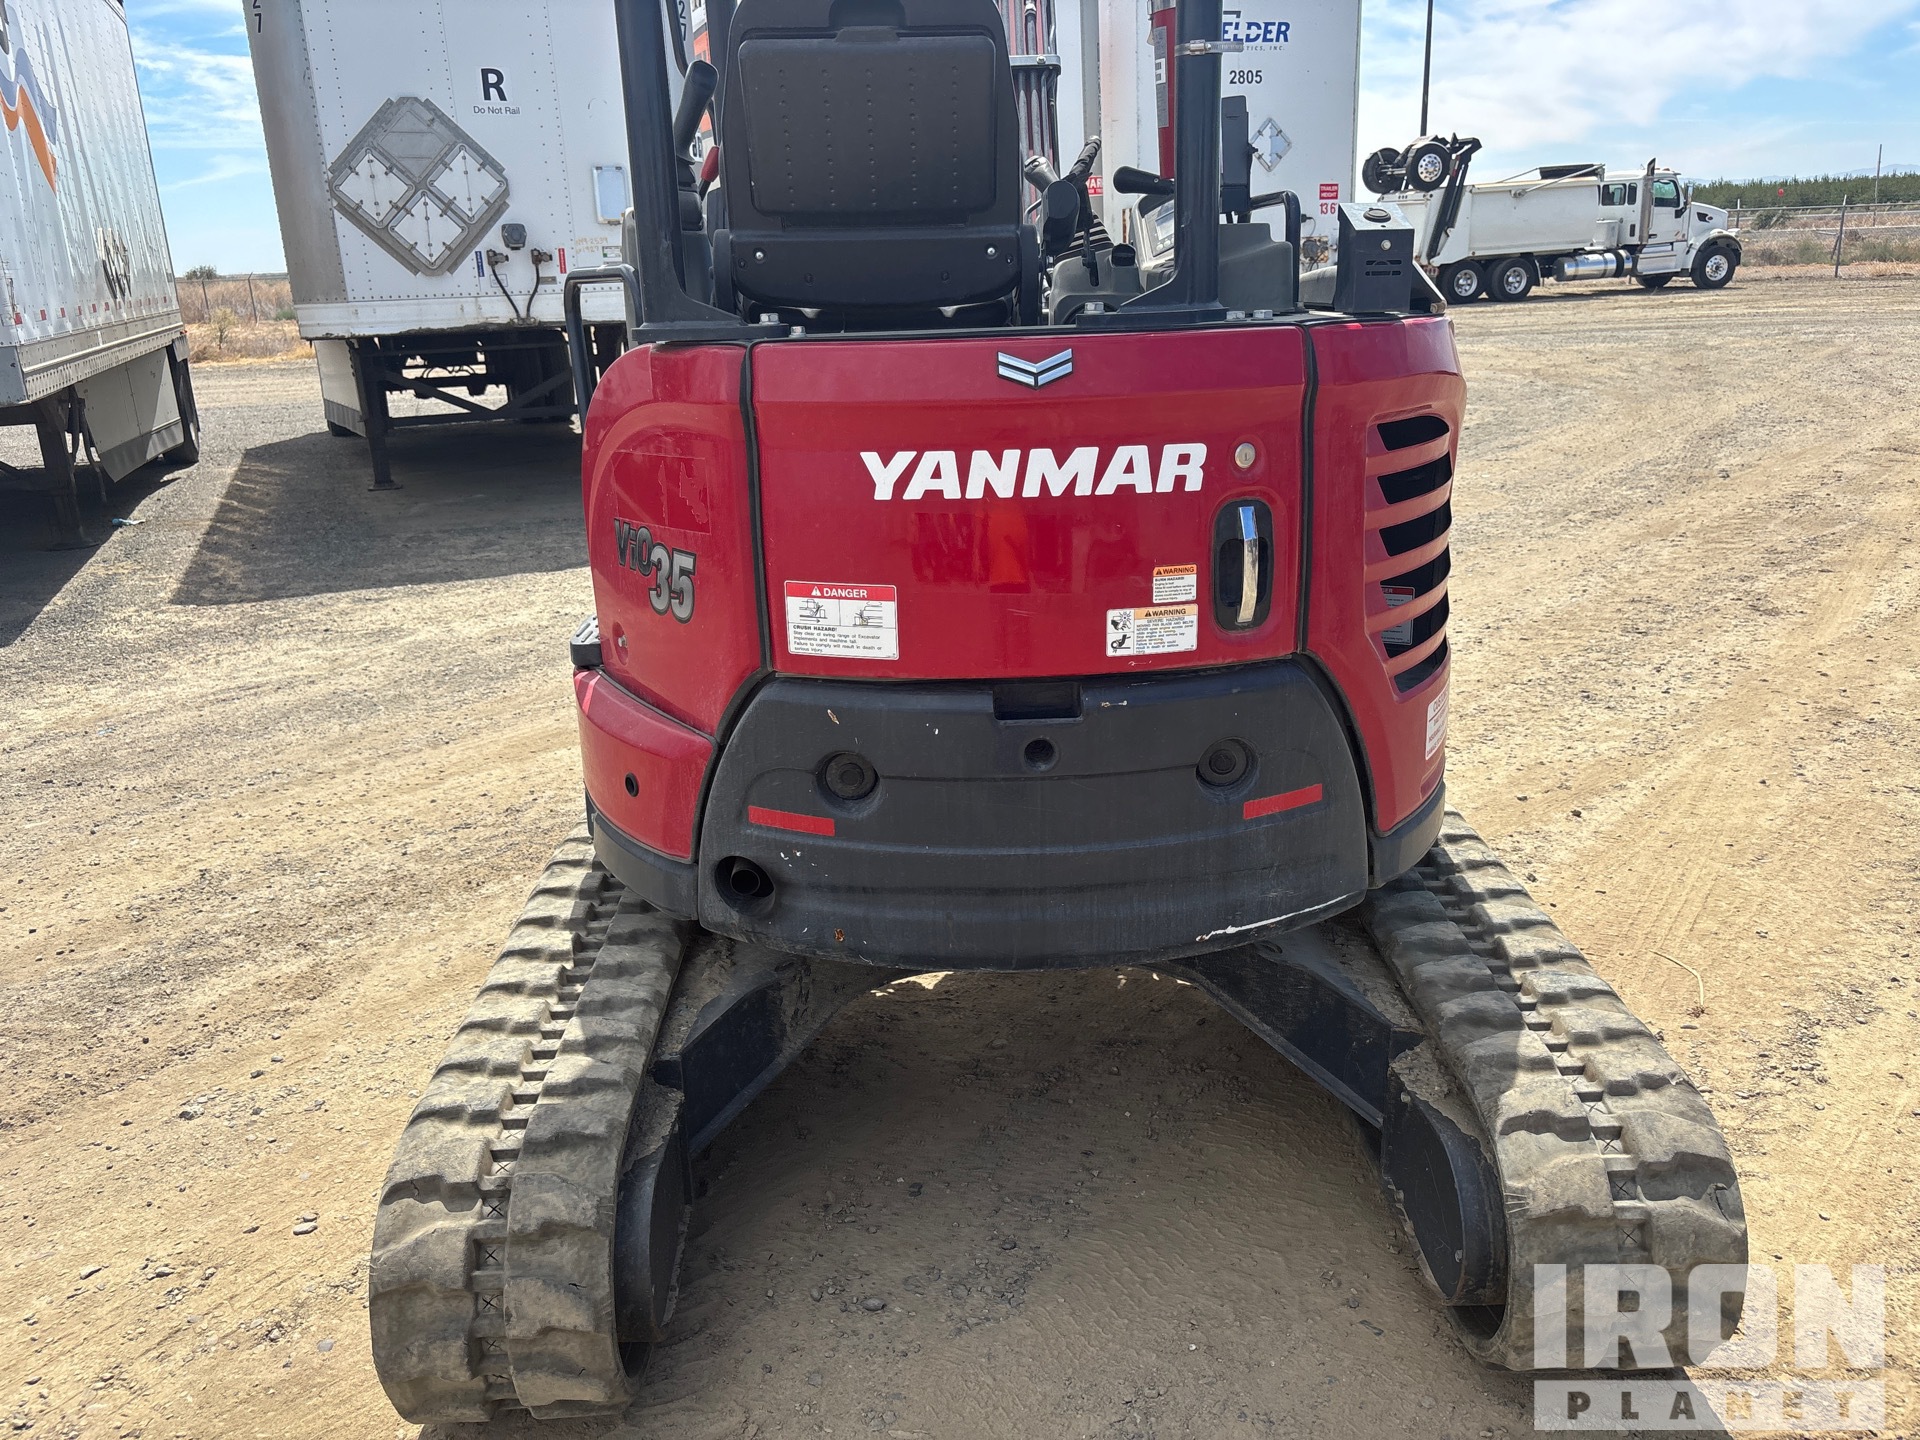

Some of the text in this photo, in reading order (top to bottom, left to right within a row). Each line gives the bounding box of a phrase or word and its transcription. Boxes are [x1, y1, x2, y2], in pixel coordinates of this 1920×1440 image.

[1229, 69, 1263, 85] 2805
[480, 68, 508, 102] R
[473, 105, 521, 115] Do Not Rail
[860, 442, 1208, 501] YANMAR
[1162, 566, 1195, 575] WARNING
[823, 588, 867, 598] DANGER
[1152, 608, 1186, 617] WARNING
